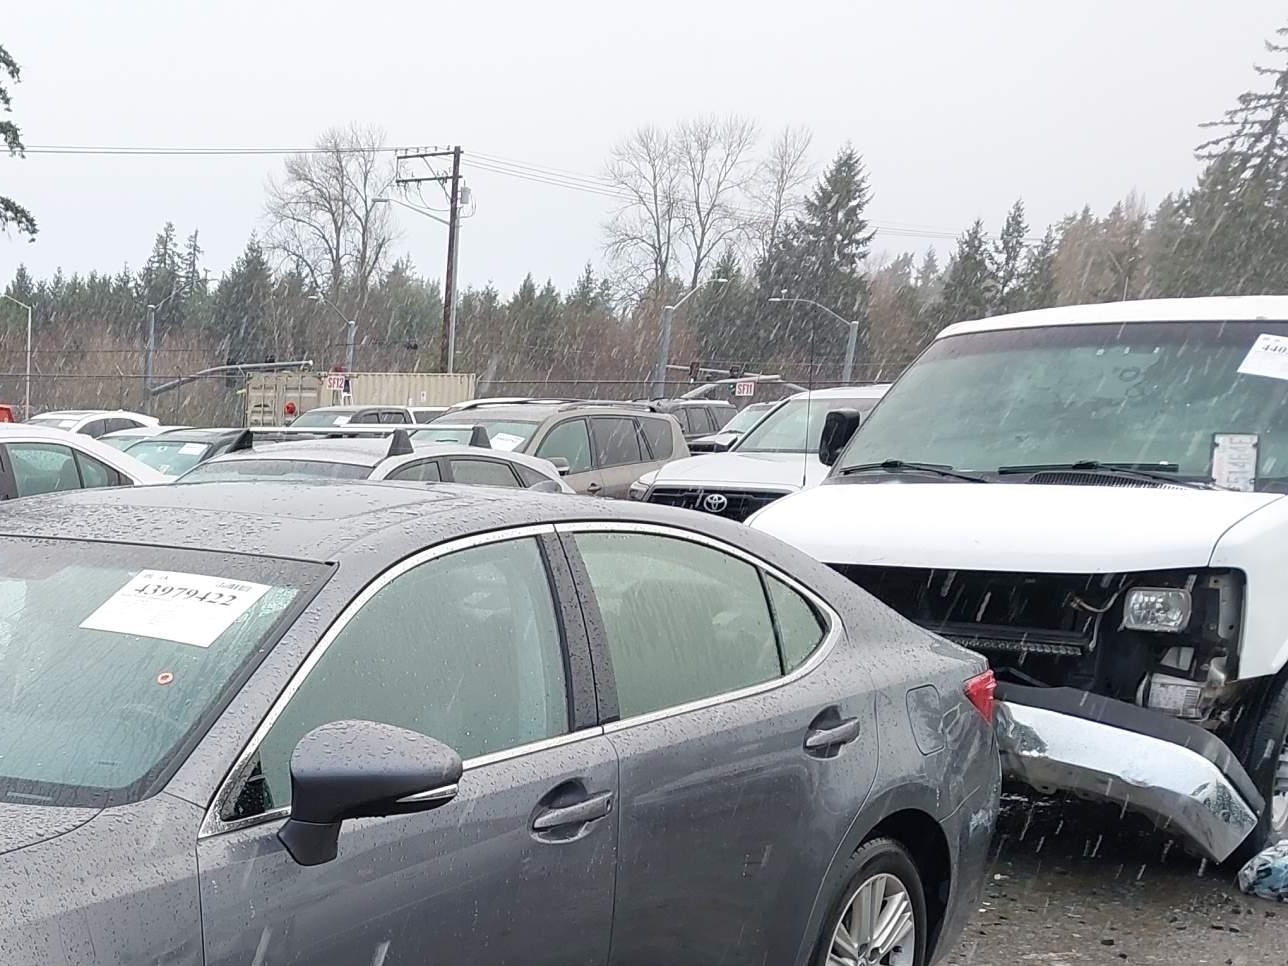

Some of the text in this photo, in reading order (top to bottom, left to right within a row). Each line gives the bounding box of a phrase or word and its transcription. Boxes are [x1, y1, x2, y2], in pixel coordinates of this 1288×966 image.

[328, 377, 344, 389] SF12
[737, 383, 753, 395] SF11
[135, 583, 237, 606] 43979422
